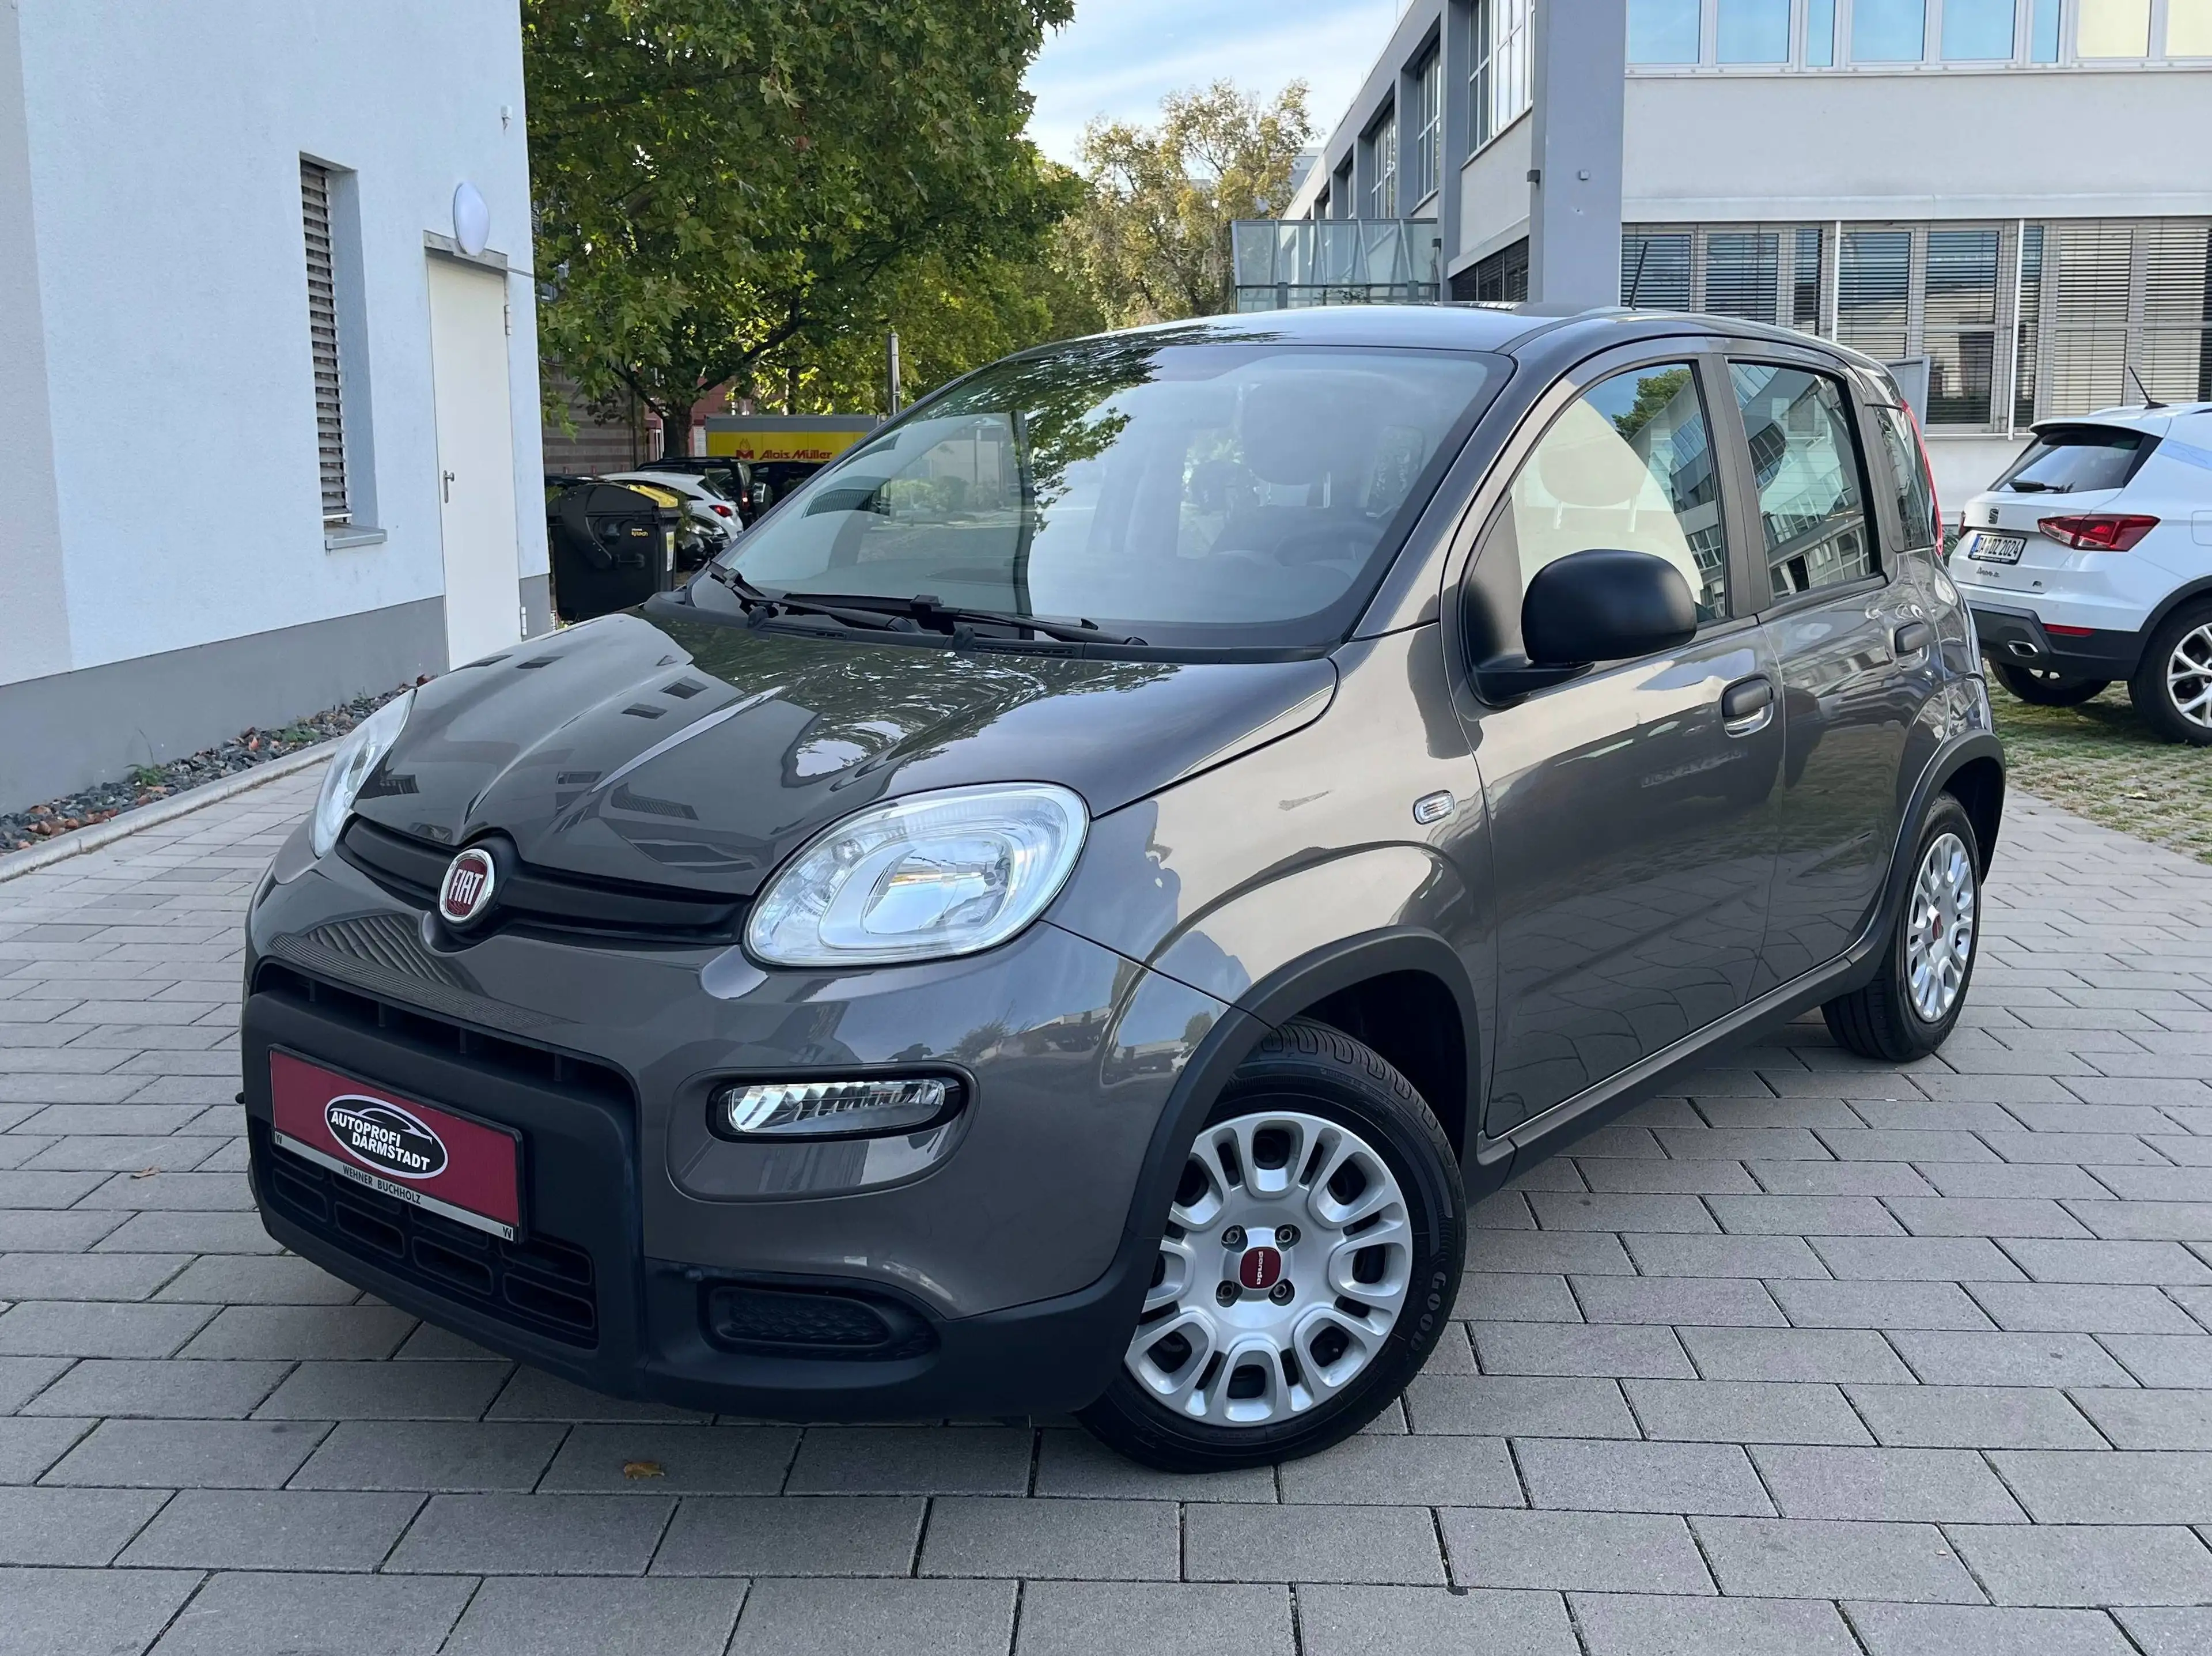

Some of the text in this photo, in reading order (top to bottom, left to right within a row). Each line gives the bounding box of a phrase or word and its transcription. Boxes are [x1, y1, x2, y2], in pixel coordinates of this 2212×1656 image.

[759, 449, 791, 460] Alois
[791, 449, 833, 460] Müller
[448, 868, 484, 905] FIAT
[331, 1111, 401, 1147] AUTOPROFI
[352, 1132, 430, 1171] DARMSTADT
[343, 1165, 422, 1205] WEHNER BUCHHOLZ
